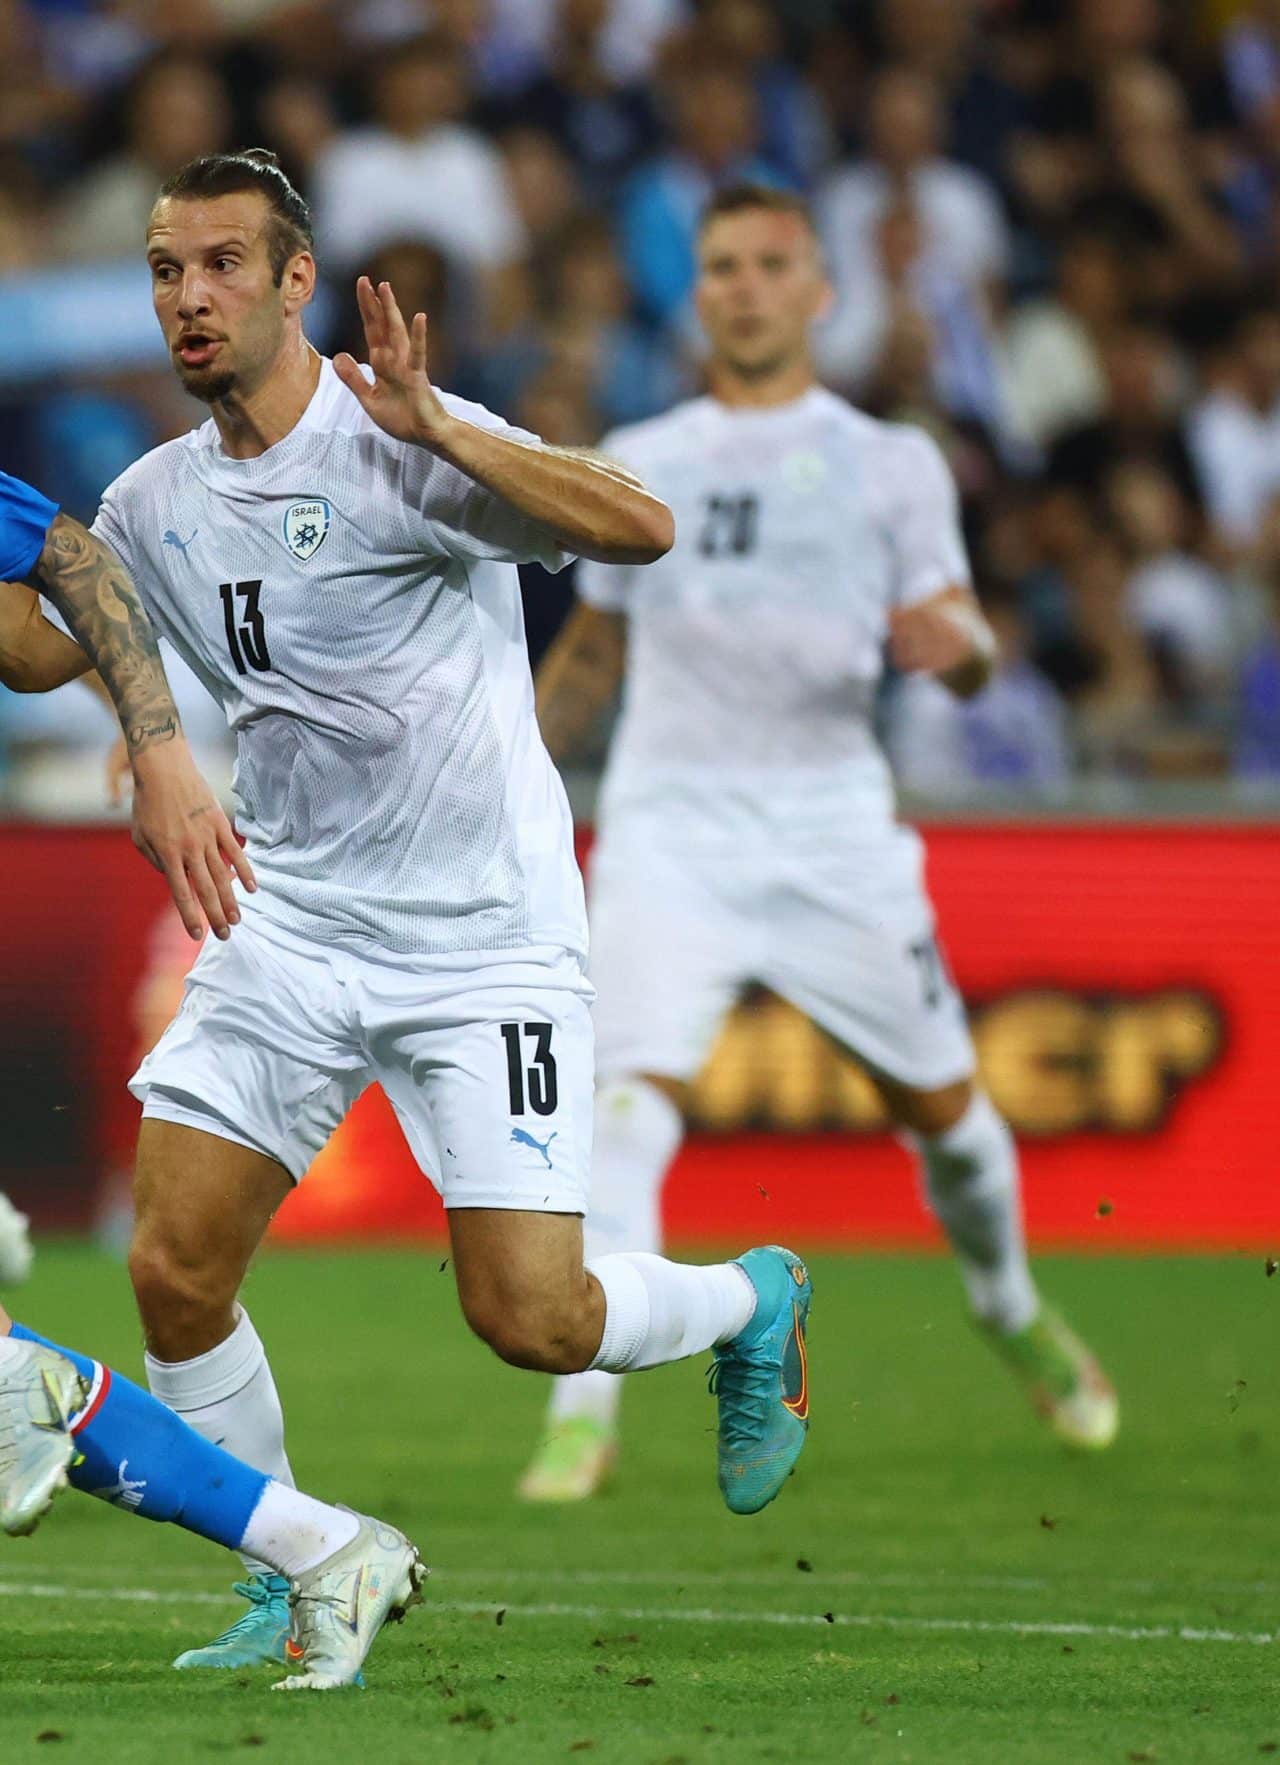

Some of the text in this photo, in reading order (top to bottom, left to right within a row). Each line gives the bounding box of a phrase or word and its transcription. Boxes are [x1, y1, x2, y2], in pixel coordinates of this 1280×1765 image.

[291, 505, 322, 517] ISRAEL
[219, 580, 271, 675] 13
[501, 1022, 558, 1116] 13
